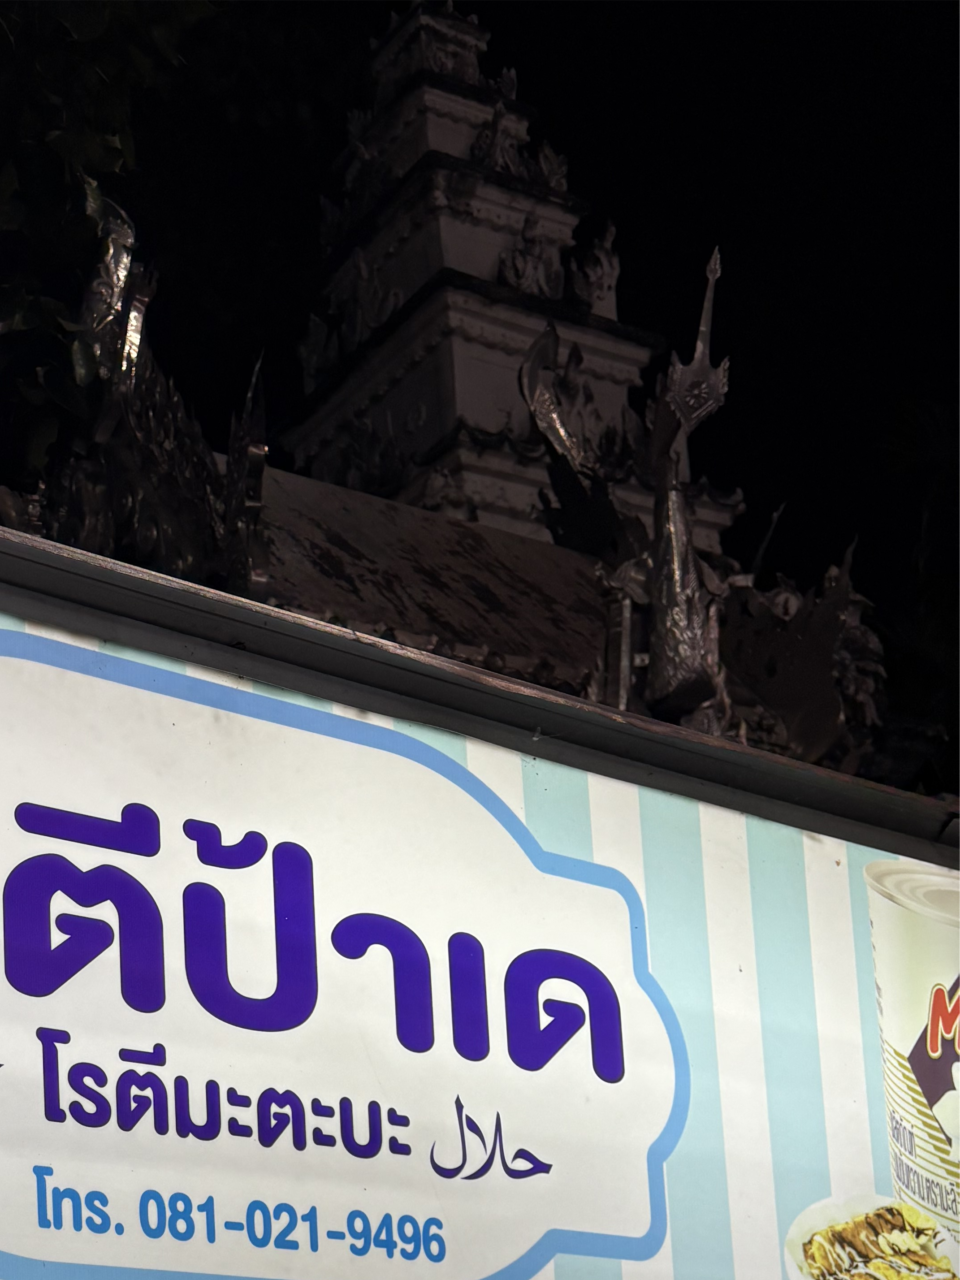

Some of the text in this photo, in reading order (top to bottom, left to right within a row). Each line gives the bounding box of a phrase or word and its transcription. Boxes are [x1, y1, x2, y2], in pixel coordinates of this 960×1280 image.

[36, 1027, 412, 1159] โรตีมะตะบะ
[430, 1094, 553, 1180] حلال
[33, 1165, 447, 1263] โทร. 081-021-9496
